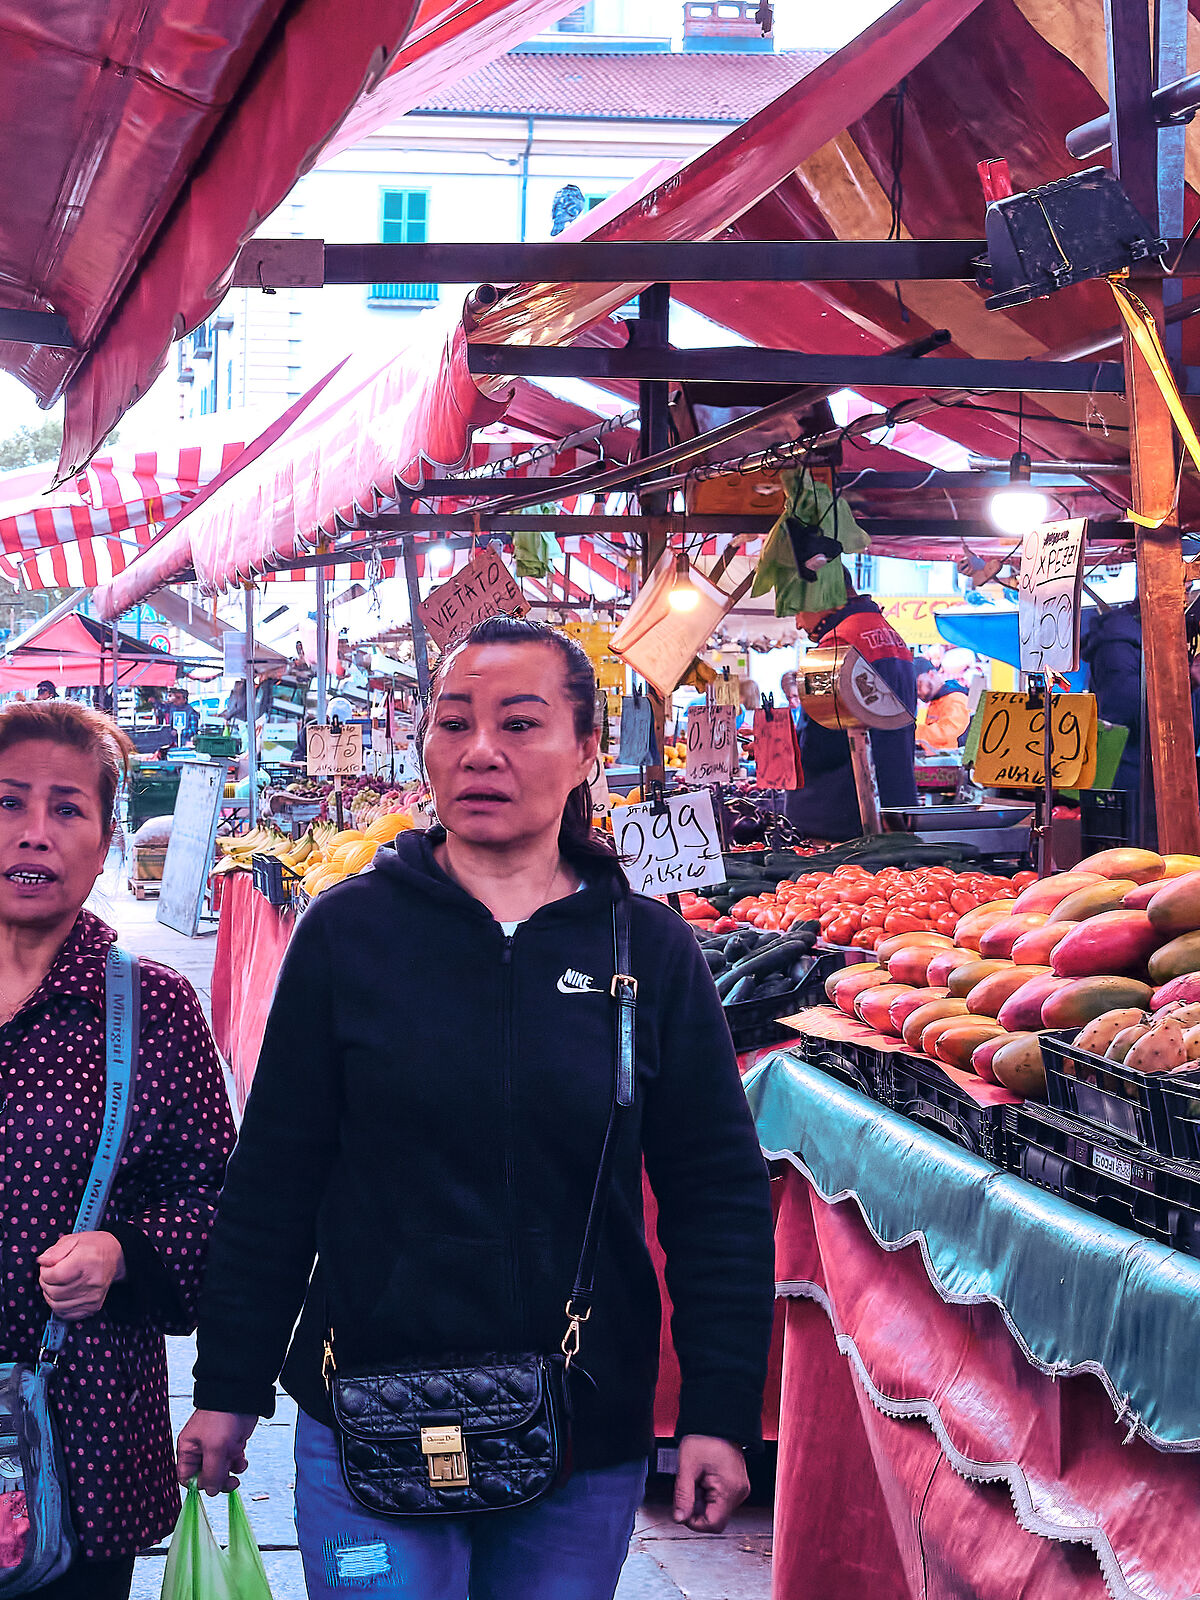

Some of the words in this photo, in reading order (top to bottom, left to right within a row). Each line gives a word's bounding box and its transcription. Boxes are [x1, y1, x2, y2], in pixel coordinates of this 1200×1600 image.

[431, 562, 500, 629] VIETATO
[309, 732, 359, 760] 0,75
[982, 709, 1081, 761] 0,99
[621, 804, 710, 870] 0,99
[563, 968, 594, 989] NIKE
